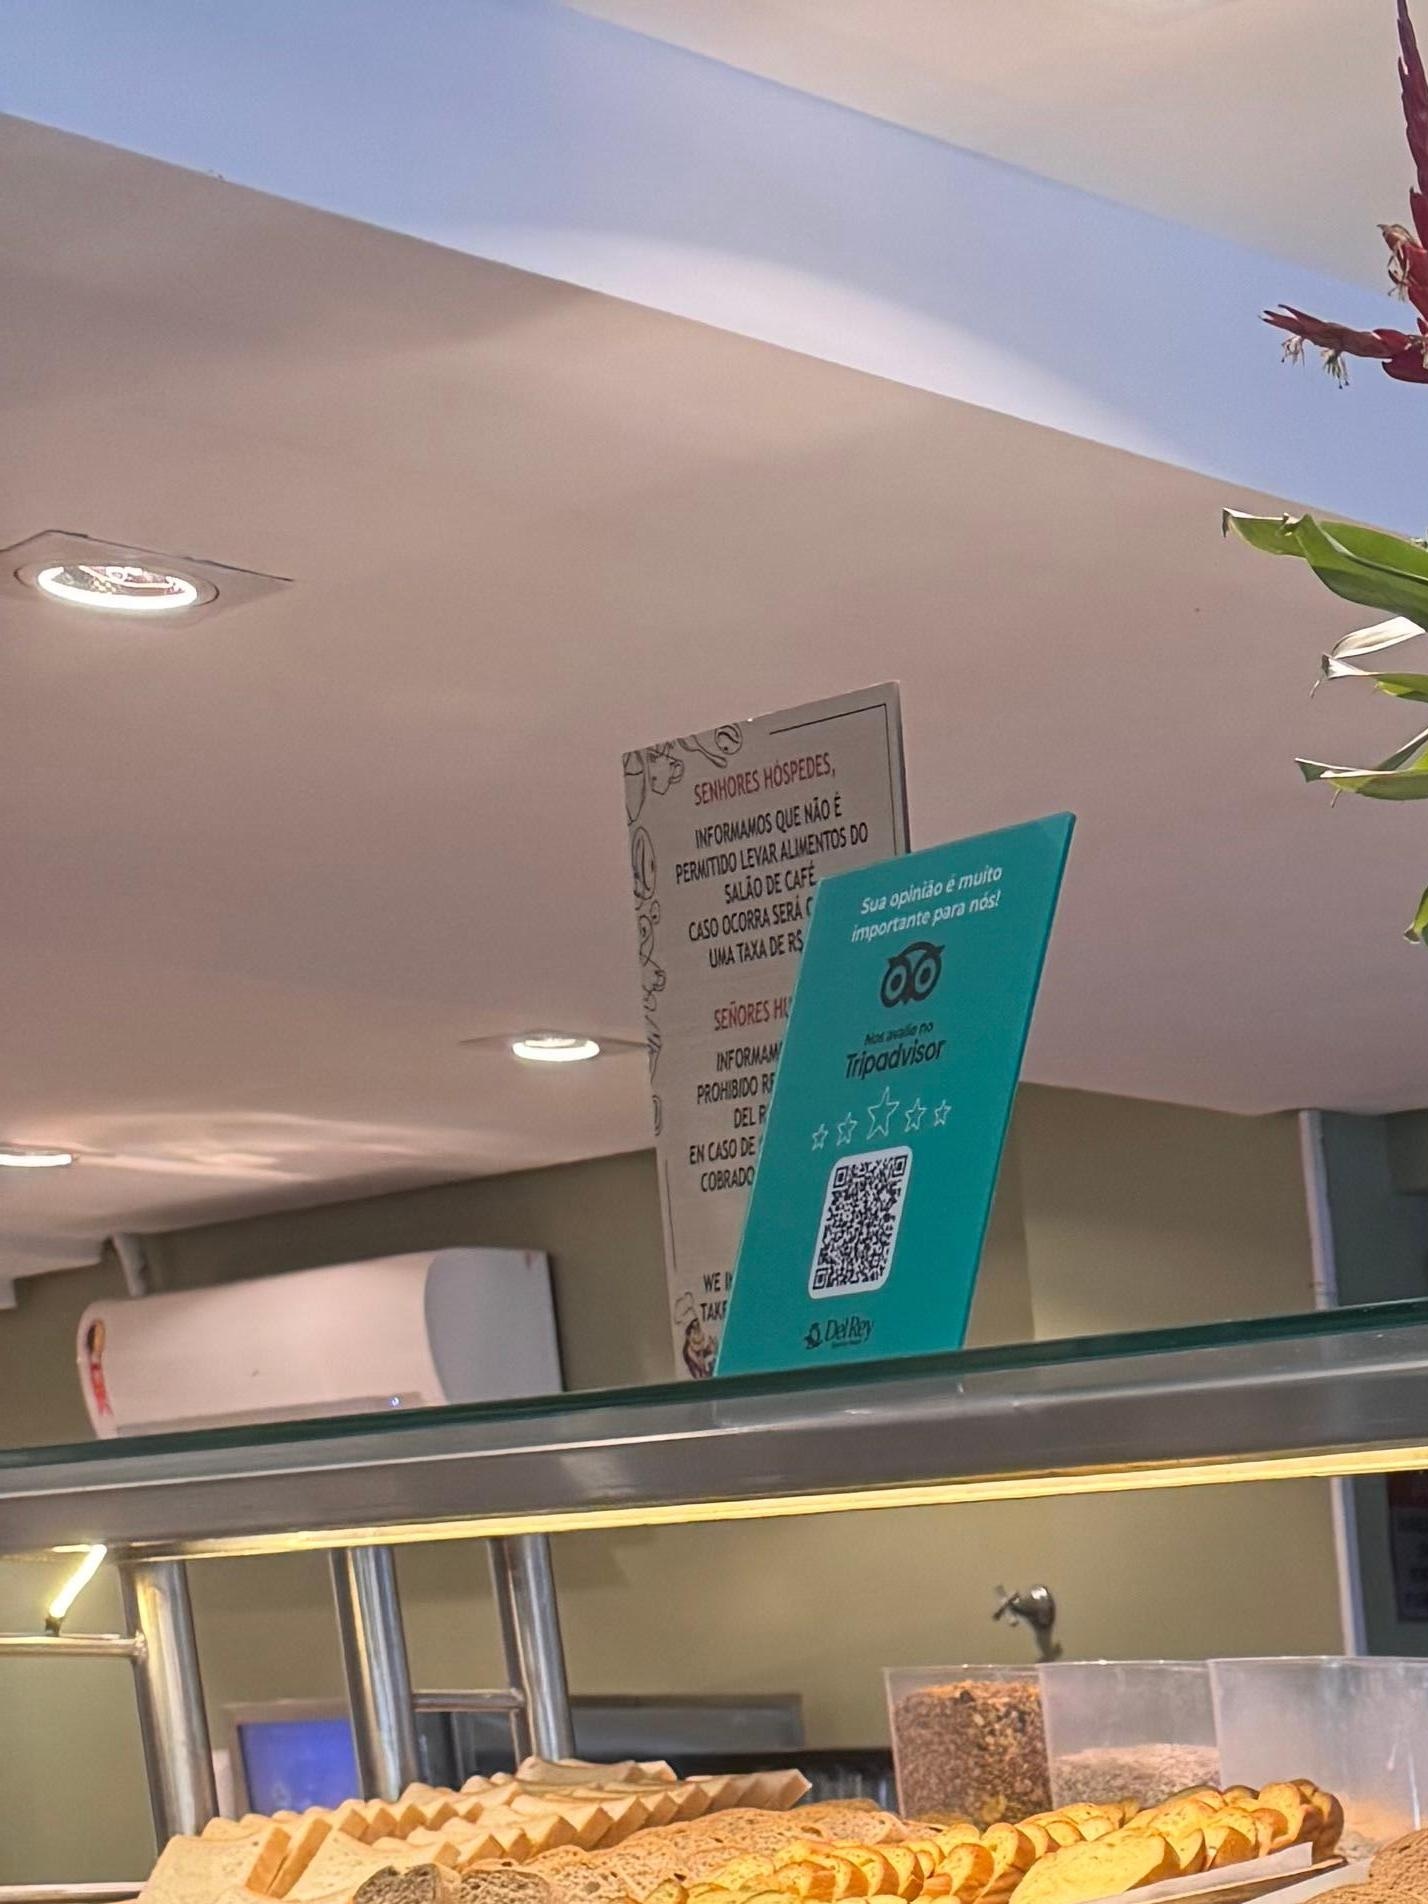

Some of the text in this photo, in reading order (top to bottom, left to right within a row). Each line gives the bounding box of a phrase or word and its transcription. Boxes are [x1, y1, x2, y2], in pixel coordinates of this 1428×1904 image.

[694, 752, 835, 806] SENHORES HÓSPEDES,
[695, 791, 841, 848] INFORMAMOS QUE NÃO É
[676, 822, 867, 884] PERMITIDO LEVAR ALIMENTOS DO
[724, 860, 815, 904] SALÃO DE CAFÉ
[861, 897, 886, 914] Sua
[890, 880, 942, 909] opinião
[959, 865, 1003, 890] muito
[851, 889, 1001, 943] importante para nós!
[714, 1000, 769, 1031] SEÑORES
[846, 1039, 946, 1080] Tripadvisor
[697, 1076, 757, 1104] PROHIBIDO
